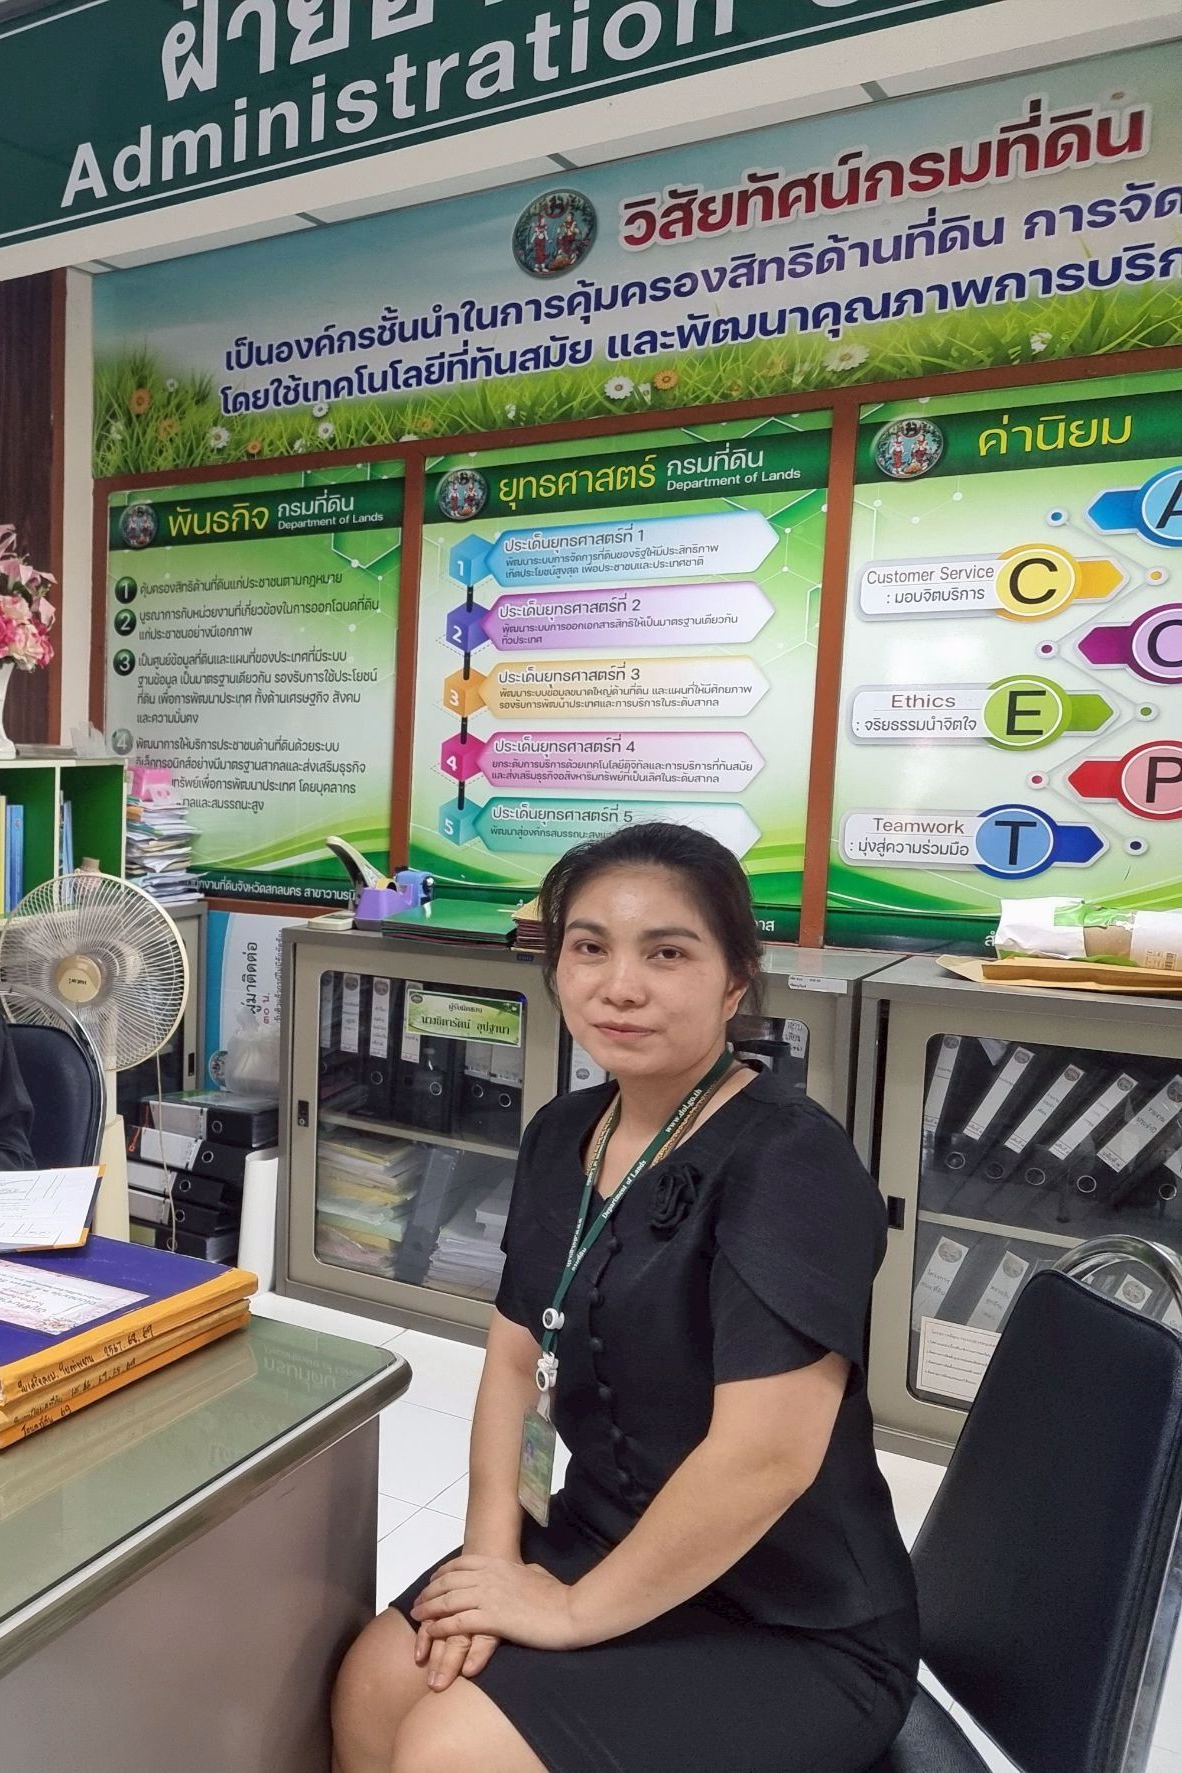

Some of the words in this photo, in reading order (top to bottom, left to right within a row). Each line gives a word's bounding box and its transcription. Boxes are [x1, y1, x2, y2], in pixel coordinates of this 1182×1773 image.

[61, 0, 733, 208] Administration
[623, 99, 1146, 248] วิสัยทัศน์กรมที่ดิน
[225, 207, 1005, 371] เป็นองค์กรชั้นนำในการคุ้มครองสิทธิด้านที่ดิน
[221, 334, 593, 415] โดยใช้เทคโนโลยีที่ทันสมัย
[978, 414, 1133, 457] ค่านิยม
[499, 454, 657, 510] ยุทธศาสตร์
[666, 443, 764, 477] กรมที่ดิน
[667, 474, 740, 491] Department
[744, 472, 758, 484] of
[761, 468, 801, 483] Lands
[169, 502, 269, 537] พันธกิจ
[277, 489, 355, 518] กรมที่ดิน
[278, 516, 336, 530] Department
[339, 515, 350, 525] of
[353, 511, 384, 524] Lands
[505, 523, 634, 553] ประเด็นยุทธศาสตร์ที่
[638, 529, 645, 542] 1
[866, 569, 936, 585] Customer
[939, 564, 995, 581] Service
[1009, 557, 1058, 604] C
[500, 593, 629, 621] ประเด็นยุทธศาสตร์ที่
[632, 598, 641, 612] 2
[894, 586, 985, 604] มอบจิตบริการ
[120, 613, 131, 631] 2
[452, 625, 463, 643] 2
[119, 654, 131, 671] 3
[499, 662, 626, 688] ประเด็นยุทธศาสตร์ที่
[630, 667, 641, 681] 3
[449, 688, 460, 706] 3
[891, 694, 957, 709] Ethics
[864, 715, 977, 731] จริยธรรมนำจิตใจ
[1005, 690, 1047, 736] E
[495, 734, 622, 757] ประเด็นยุทธศาสตร์ที่
[626, 741, 636, 753] 4
[446, 754, 458, 772] 4
[1145, 756, 1182, 804] P
[443, 817, 454, 835] 5
[493, 804, 619, 825] ประเด็นยุทธศาสตร์ที่
[623, 810, 633, 823] 5
[872, 817, 965, 835] Teamwork
[858, 837, 970, 857] มุ่งสู่ความร่วมมือ
[995, 820, 1037, 865] T
[664, 1088, 704, 1134] www.dol.go.th
[602, 1183, 628, 1220] Department
[630, 1159, 648, 1181] Lands
